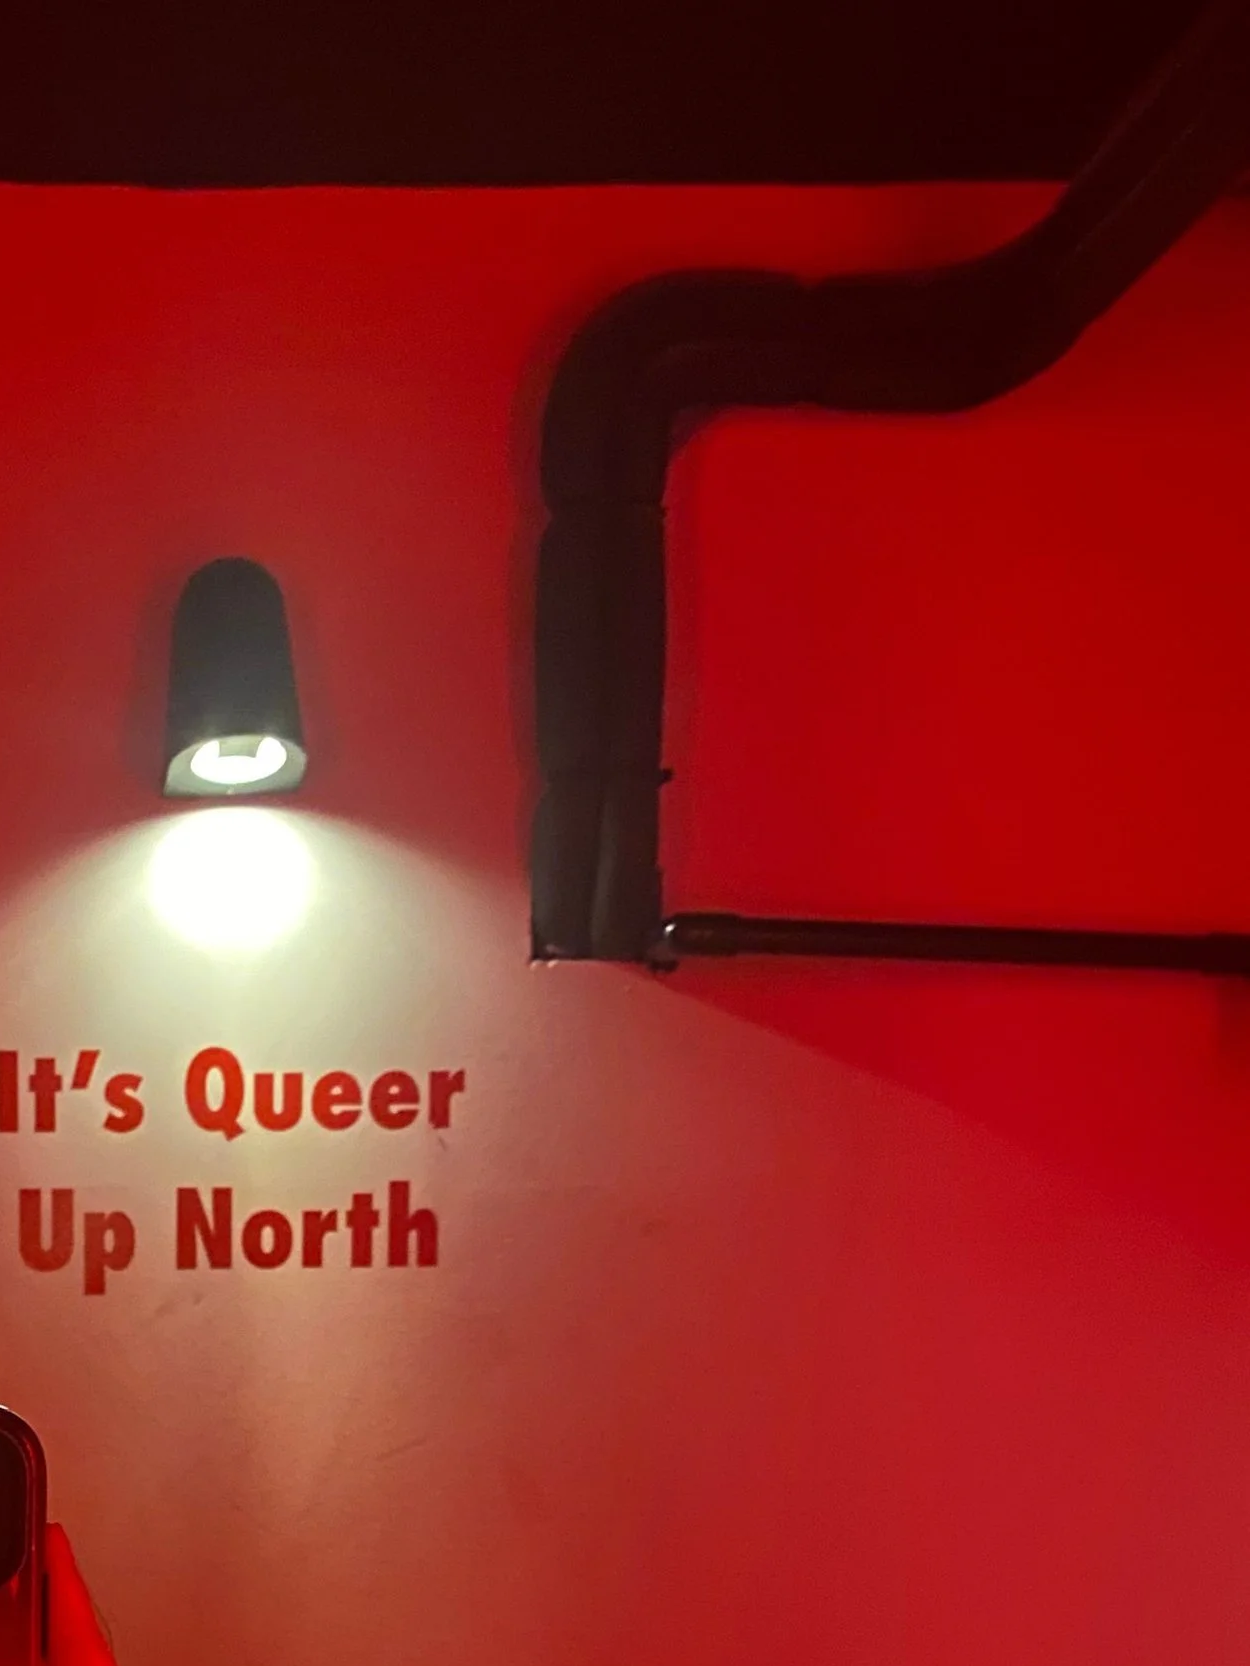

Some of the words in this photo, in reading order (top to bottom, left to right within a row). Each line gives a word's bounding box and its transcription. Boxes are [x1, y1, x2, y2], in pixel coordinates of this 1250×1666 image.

[185, 1046, 466, 1142] Queer
[19, 1188, 135, 1295] Up
[176, 1180, 438, 1270] North
